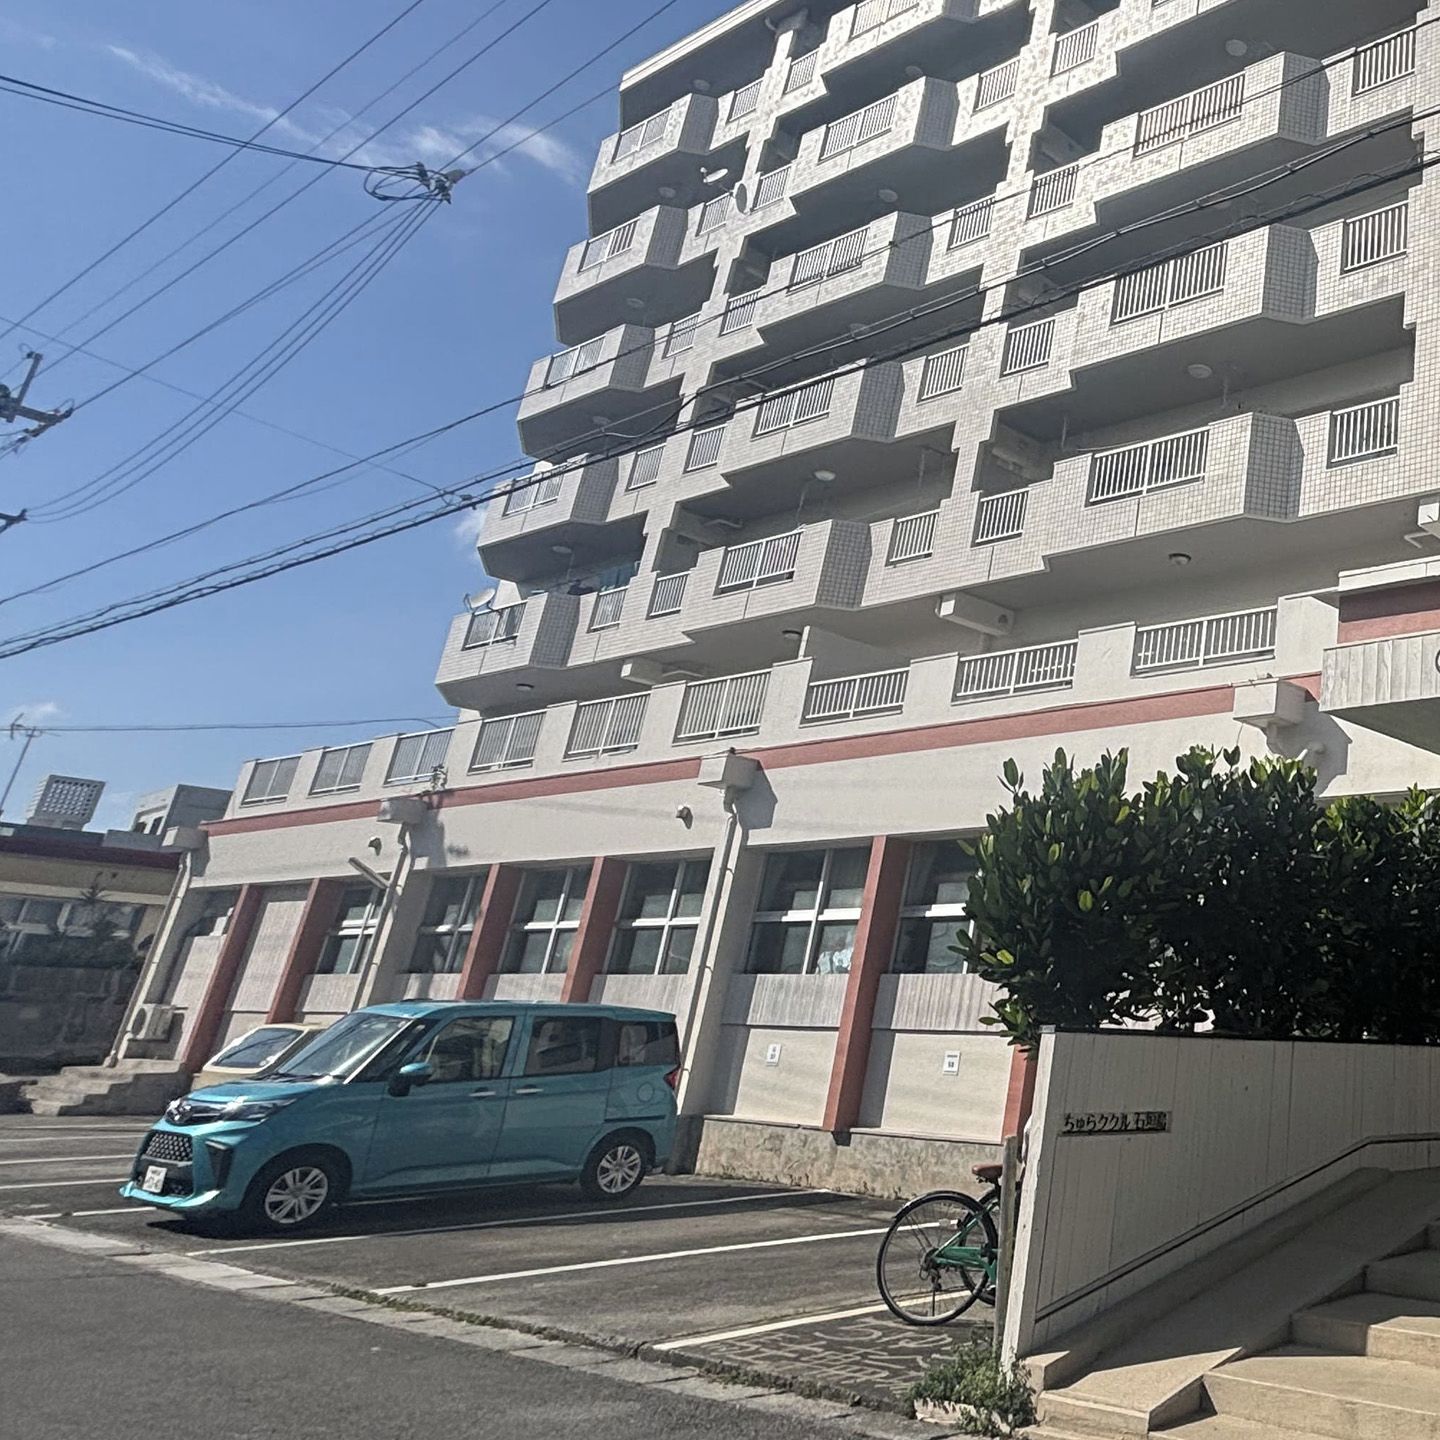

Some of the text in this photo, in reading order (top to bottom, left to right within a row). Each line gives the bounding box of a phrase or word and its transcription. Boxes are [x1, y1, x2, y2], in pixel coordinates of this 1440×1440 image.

[1063, 1112, 1131, 1131] ちゅらククル
